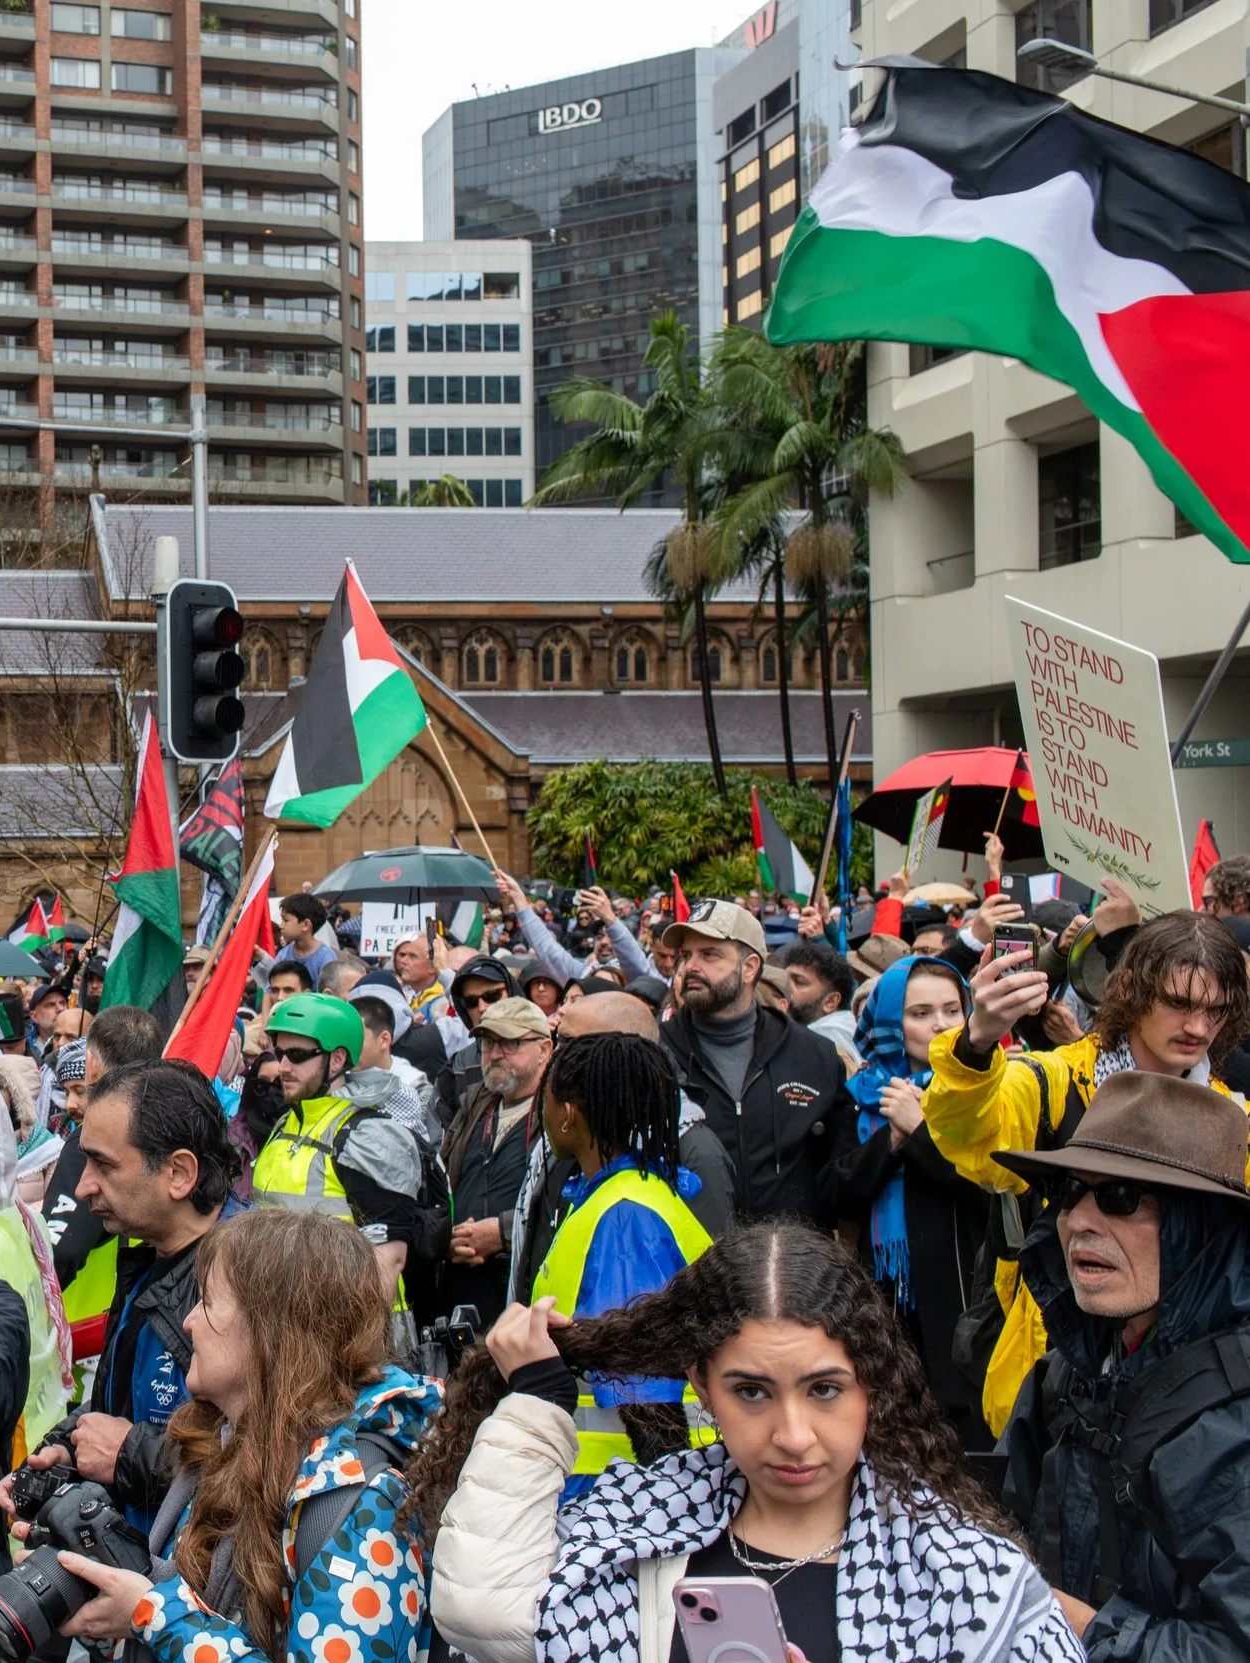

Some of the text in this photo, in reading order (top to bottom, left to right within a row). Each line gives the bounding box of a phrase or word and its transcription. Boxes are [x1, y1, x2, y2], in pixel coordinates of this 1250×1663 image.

[544, 98, 602, 128] BDO
[1021, 620, 1124, 685] TO STAND
[1025, 650, 1078, 695] WITH
[1031, 680, 1139, 750] PALESTINE
[1036, 708, 1086, 751] IS TO
[1041, 737, 1108, 788] STAND
[1183, 742, 1231, 758] York St
[1045, 764, 1098, 810] WITH
[1051, 792, 1152, 863] HUMANITY
